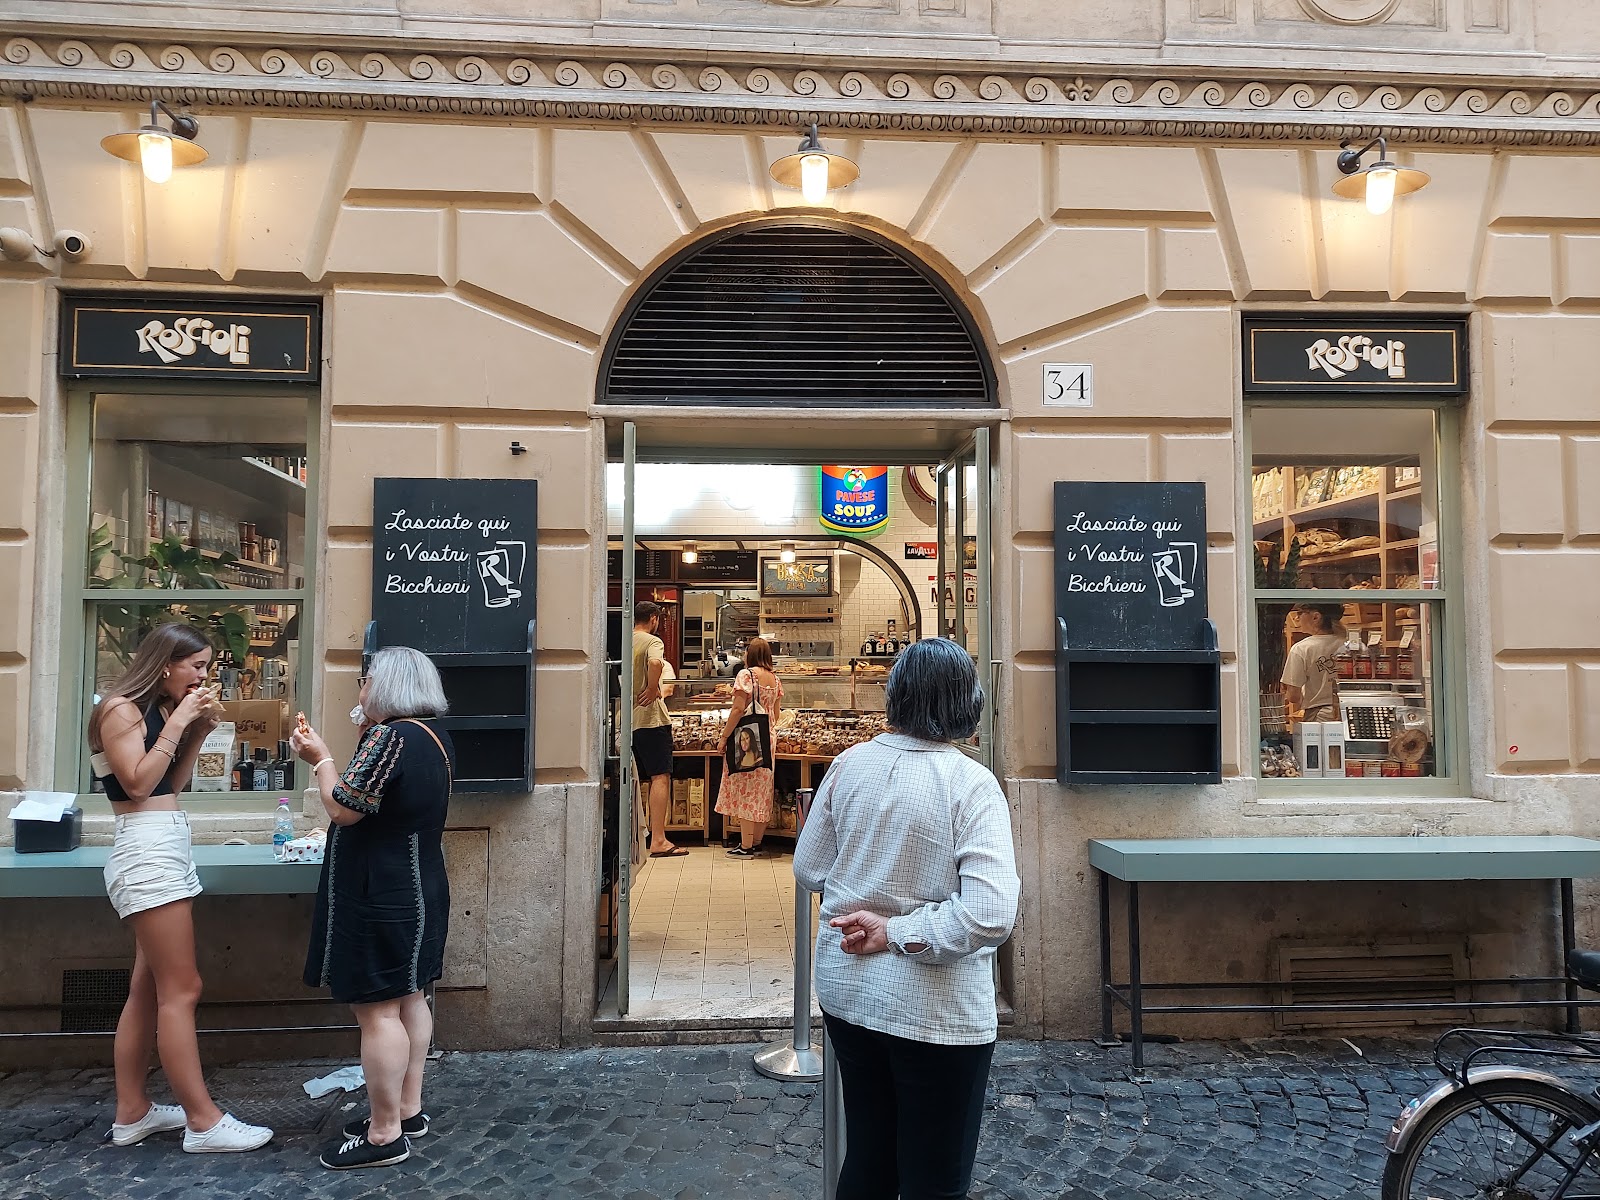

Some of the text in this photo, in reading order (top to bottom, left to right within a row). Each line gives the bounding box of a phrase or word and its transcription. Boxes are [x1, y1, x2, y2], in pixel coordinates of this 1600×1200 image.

[1047, 370, 1089, 400] 34
[835, 489, 875, 503] PAVESE
[834, 503, 876, 517] SOUP
[384, 509, 511, 538] Lasciate qui
[1066, 511, 1183, 539] Lasciate qui
[385, 541, 470, 562] i Vostri
[906, 546, 936, 557] LAVAZZA
[1067, 543, 1145, 562] i Vostri
[384, 574, 471, 594] Bicchieri
[1067, 573, 1147, 593] Bicchieri
[233, 720, 267, 734] oscioli
